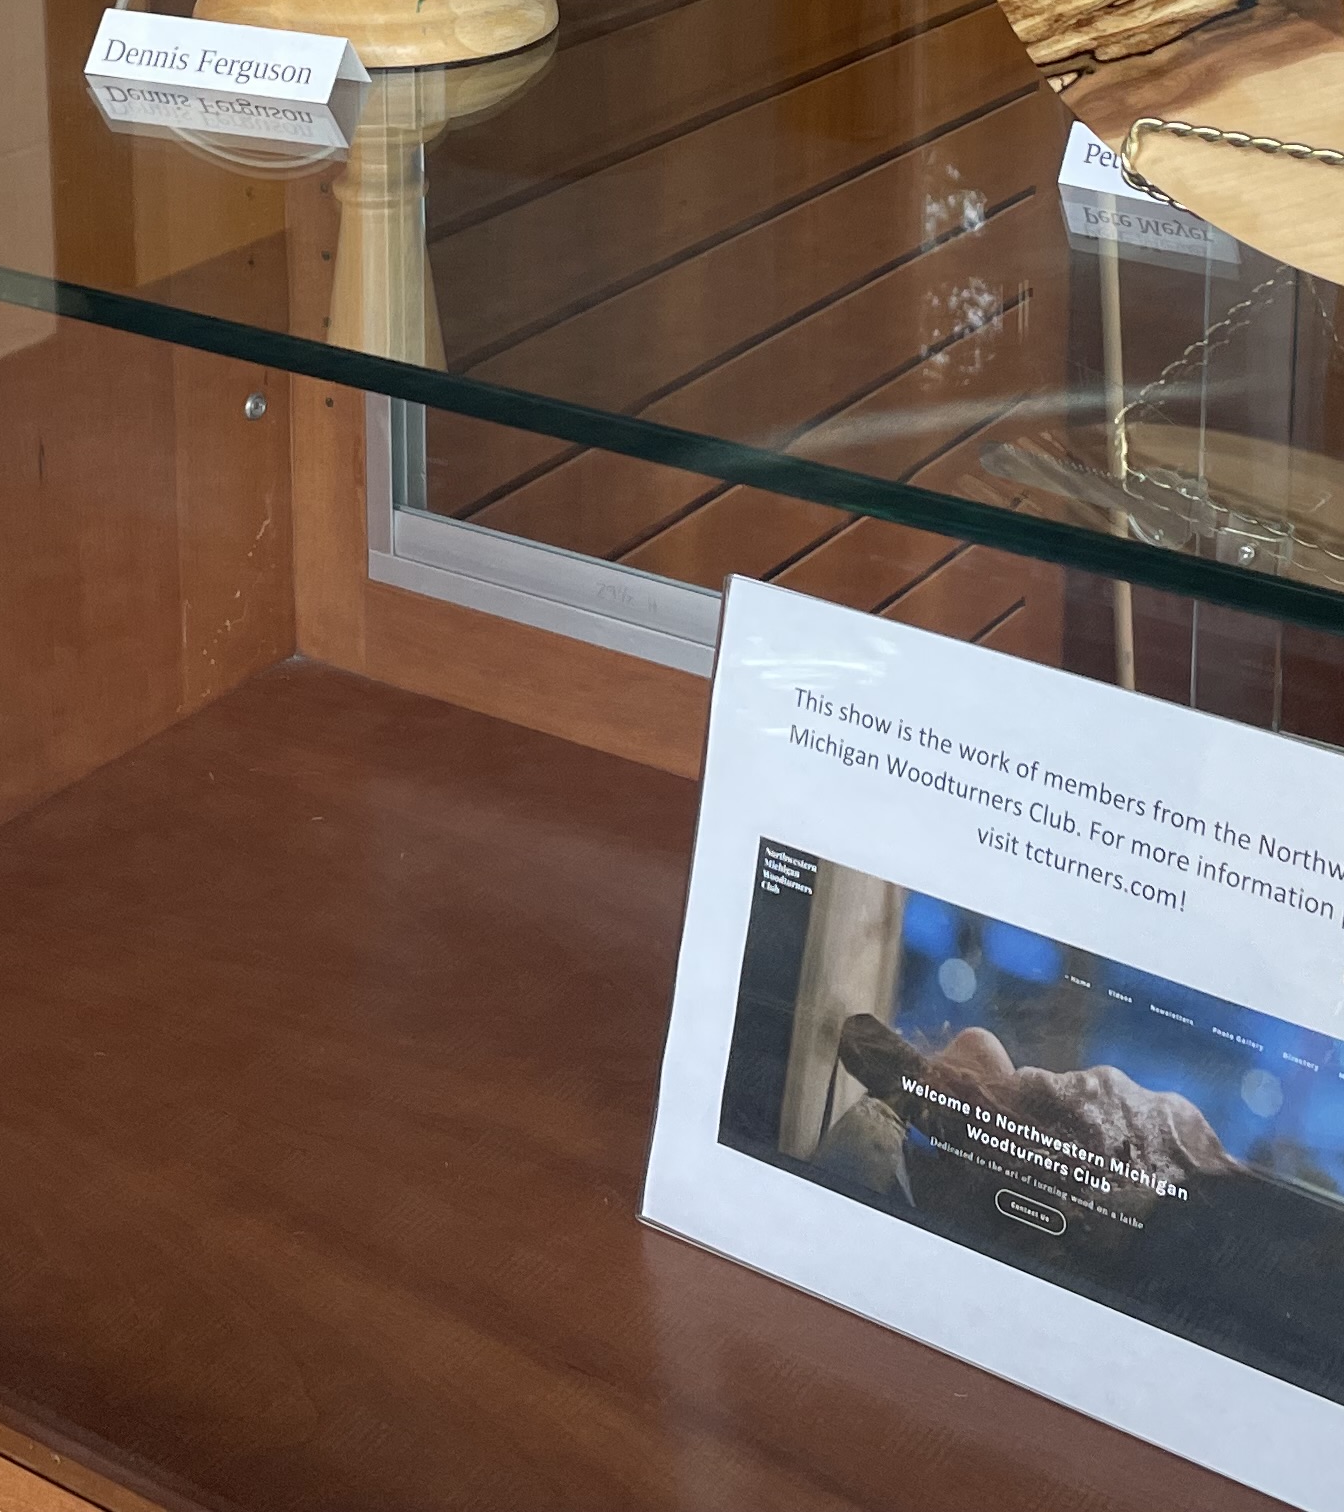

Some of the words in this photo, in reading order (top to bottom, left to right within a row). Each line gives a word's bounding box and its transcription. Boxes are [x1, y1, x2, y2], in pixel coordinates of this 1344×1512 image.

[102, 38, 189, 71] Dennis
[196, 49, 313, 85] Ferguson
[1083, 143, 1120, 169] Pet
[794, 687, 834, 717] This
[838, 702, 892, 736] show
[897, 718, 913, 742] is
[918, 727, 953, 755] the
[958, 742, 1011, 774] work
[1016, 759, 1040, 782] of
[1043, 770, 1147, 817] members
[1152, 799, 1206, 837] from
[1213, 820, 1252, 851] the
[789, 723, 880, 771] Michigan
[886, 753, 1023, 817] Woodturners
[1029, 801, 1081, 837] Club.
[1089, 820, 1126, 850] For
[1130, 838, 1190, 873] more
[1196, 854, 1334, 921] information
[977, 826, 1020, 857] visit
[1025, 840, 1187, 913] tcturners.com!
[902, 1076, 970, 1115] Welcome
[975, 1106, 991, 1122] to
[996, 1113, 1105, 1167] Northwestern
[1109, 1157, 1189, 1201] Michigan
[930, 1136, 974, 1162] Dedicated
[976, 1153, 986, 1165] to
[988, 1156, 1003, 1172] the
[1005, 1168, 1019, 1180] art
[1021, 1174, 1032, 1184] of
[1033, 1178, 1068, 1201] turning
[1070, 1194, 1094, 1211] wood
[1096, 1204, 1109, 1215] on
[966, 1124, 1069, 1176] Woodturners
[1073, 1167, 1111, 1193] Club
